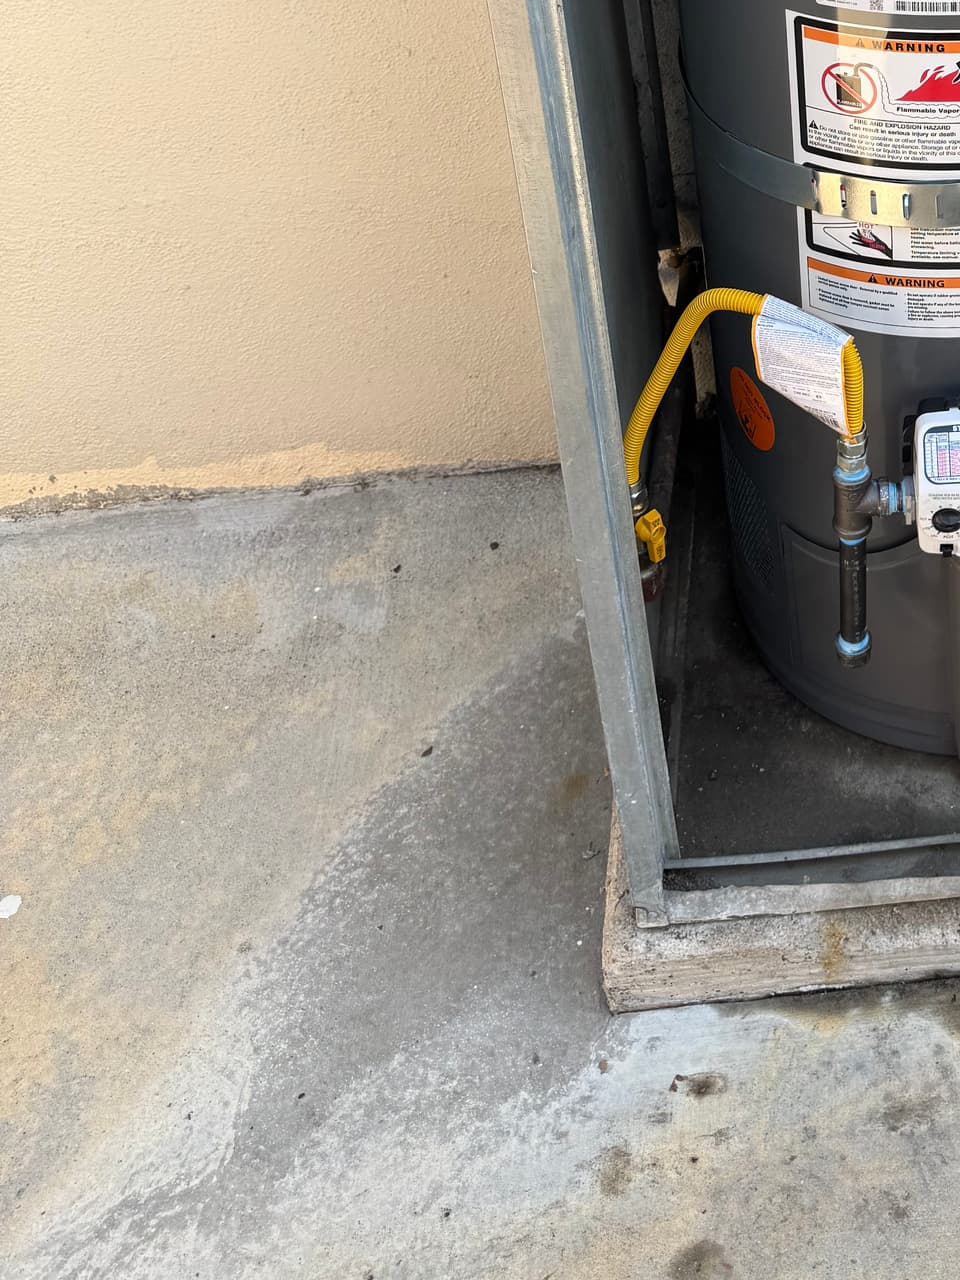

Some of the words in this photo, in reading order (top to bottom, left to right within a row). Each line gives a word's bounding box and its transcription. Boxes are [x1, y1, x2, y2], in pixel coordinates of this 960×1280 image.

[871, 40, 945, 53] WARNING
[896, 106, 936, 114] Flammable
[838, 128, 851, 136] store
[870, 134, 894, 142] gasoline
[883, 147, 901, 155] liquids
[885, 276, 945, 288] WARNING
